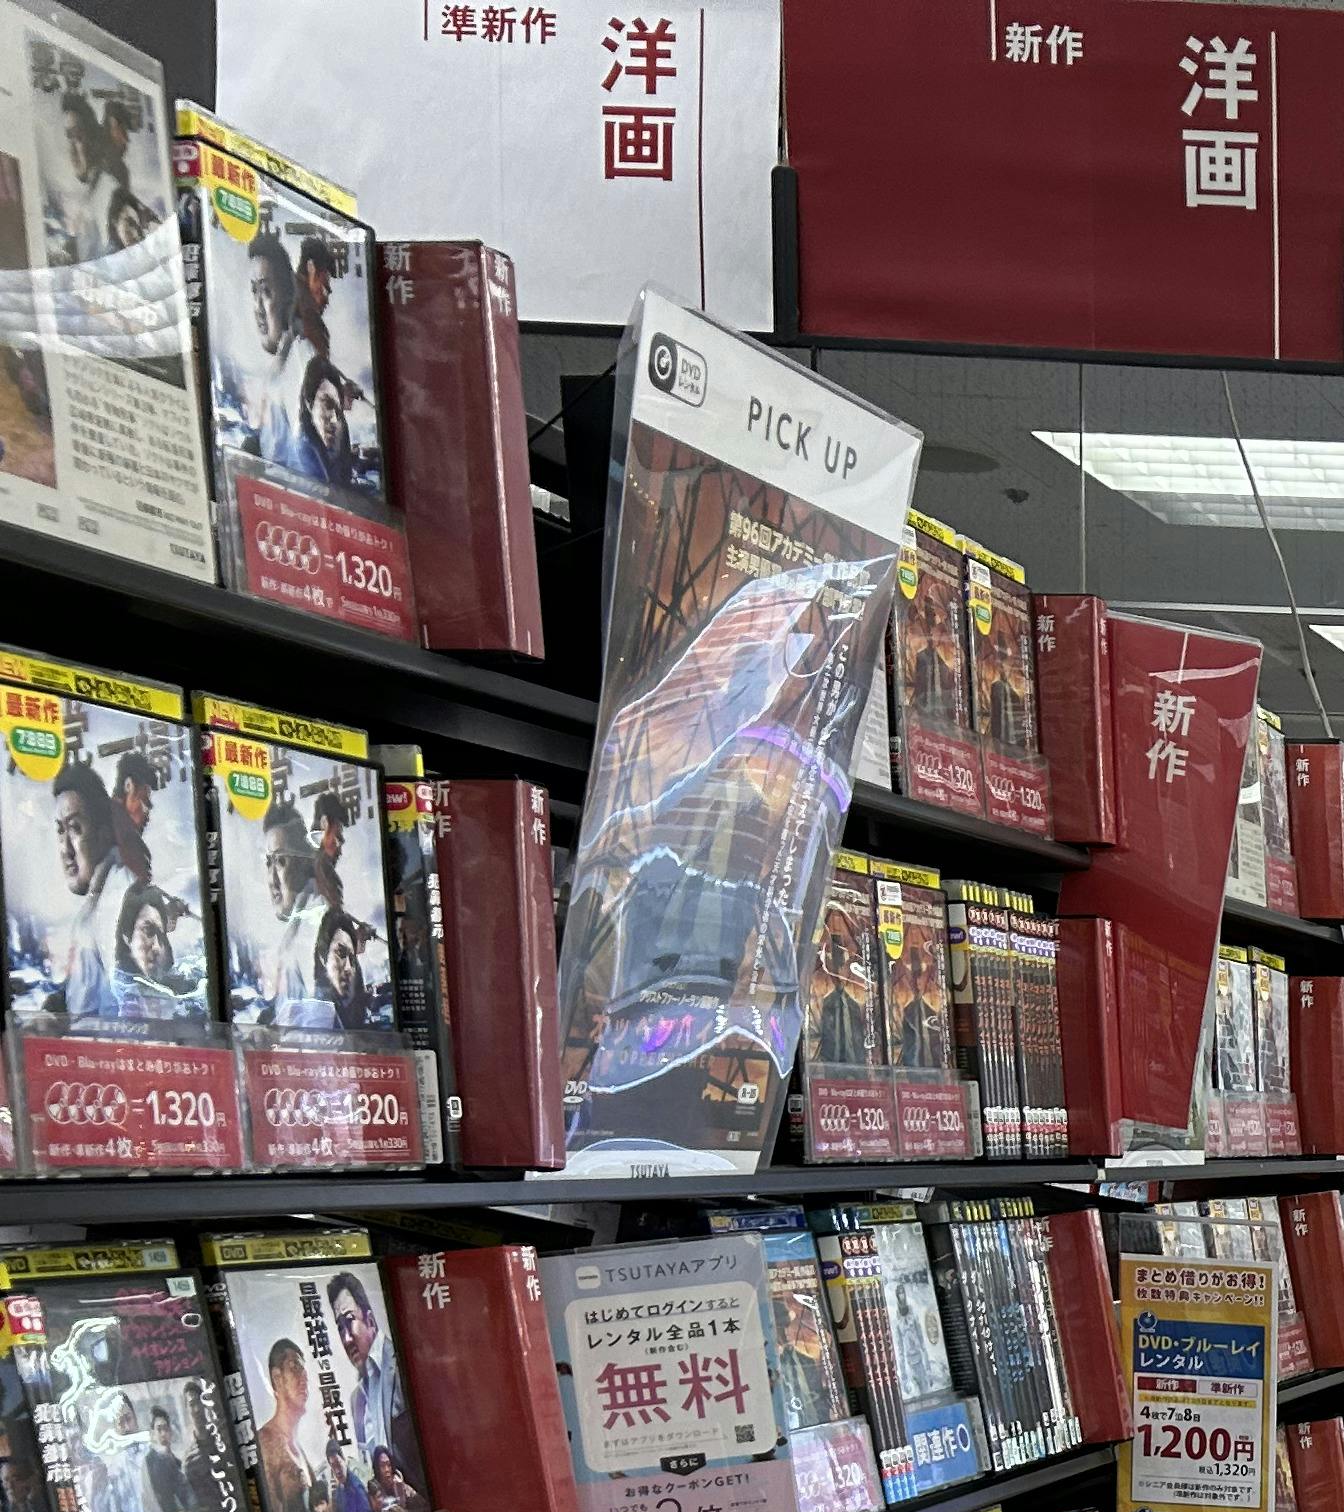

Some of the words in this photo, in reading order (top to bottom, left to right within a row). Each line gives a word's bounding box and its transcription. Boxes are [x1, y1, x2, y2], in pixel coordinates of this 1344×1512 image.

[441, 5, 556, 43] 準新作
[1005, 23, 1084, 65] 新作
[601, 17, 677, 181] 洋画
[1180, 35, 1259, 209] 洋画
[681, 358, 701, 380] DVD
[748, 395, 811, 461] PICK
[825, 436, 858, 479] UP
[336, 551, 402, 602] 1,320円
[1036, 614, 1056, 652] 新作
[5, 692, 61, 724] 最新作
[1146, 691, 1197, 784] 新作
[224, 741, 270, 769] 最新作
[1295, 758, 1310, 787] 新作
[531, 787, 547, 845] 新作
[147, 1090, 228, 1128] 1,320円
[1292, 1207, 1310, 1237] 新作
[418, 1252, 451, 1311] 新作
[521, 1247, 543, 1302] 新作
[604, 1256, 739, 1284] TSUTAYAアプリ
[1137, 1268, 1265, 1289] まとめ借りがお得!
[585, 1297, 741, 1324] はじめてログインすると
[587, 1318, 742, 1350] レンタル全品1本
[1138, 1333, 1261, 1358] DVD・ブルーレイ
[1140, 1352, 1203, 1370] レンタル
[596, 1349, 750, 1431] 無料
[1155, 1378, 1179, 1390] 新作
[914, 1429, 958, 1466] 関連作
[1137, 1424, 1255, 1463] 1,200円
[669, 1457, 700, 1470] さらに
[1198, 1463, 1256, 1477] 税込1,320円
[625, 1473, 751, 1498] お得なクーポンGET!
